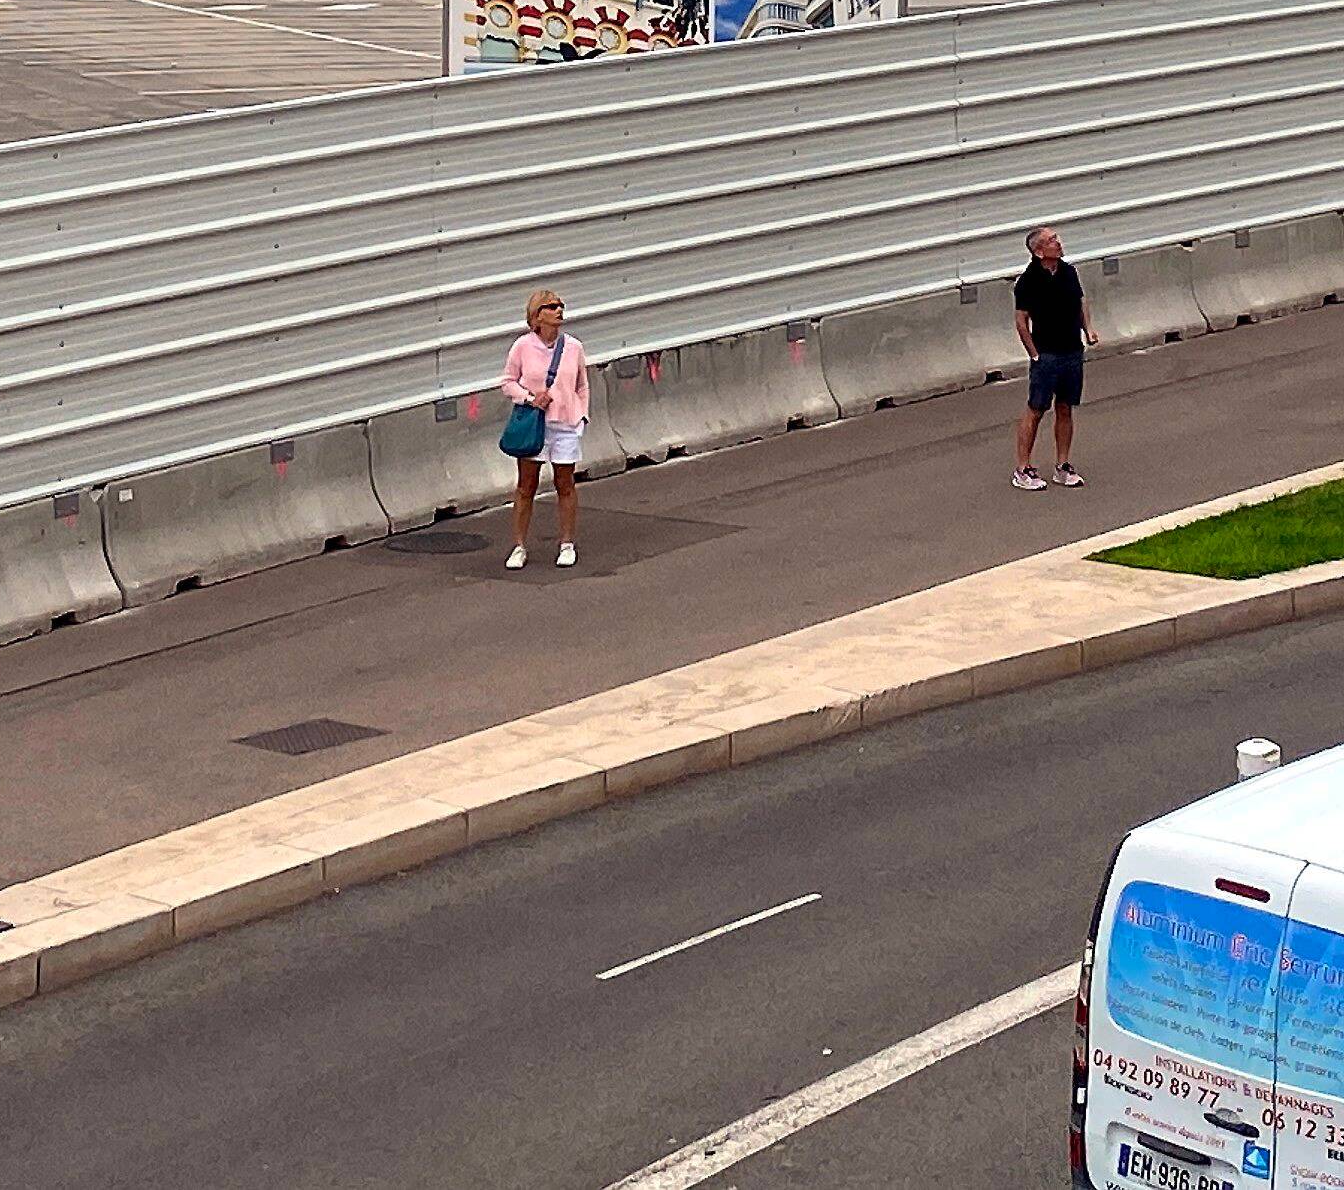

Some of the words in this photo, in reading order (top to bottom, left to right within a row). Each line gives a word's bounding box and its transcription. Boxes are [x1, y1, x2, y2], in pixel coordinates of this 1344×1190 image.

[1093, 1049, 1113, 1071] 04
[1119, 1058, 1139, 1081] 92
[1143, 1068, 1164, 1090] 09
[1170, 1077, 1191, 1100] 89
[1198, 1086, 1220, 1108] 77
[1155, 1054, 1237, 1093] INSTALLATIONS
[1262, 1108, 1286, 1130] 06
[1295, 1117, 1318, 1139] 12
